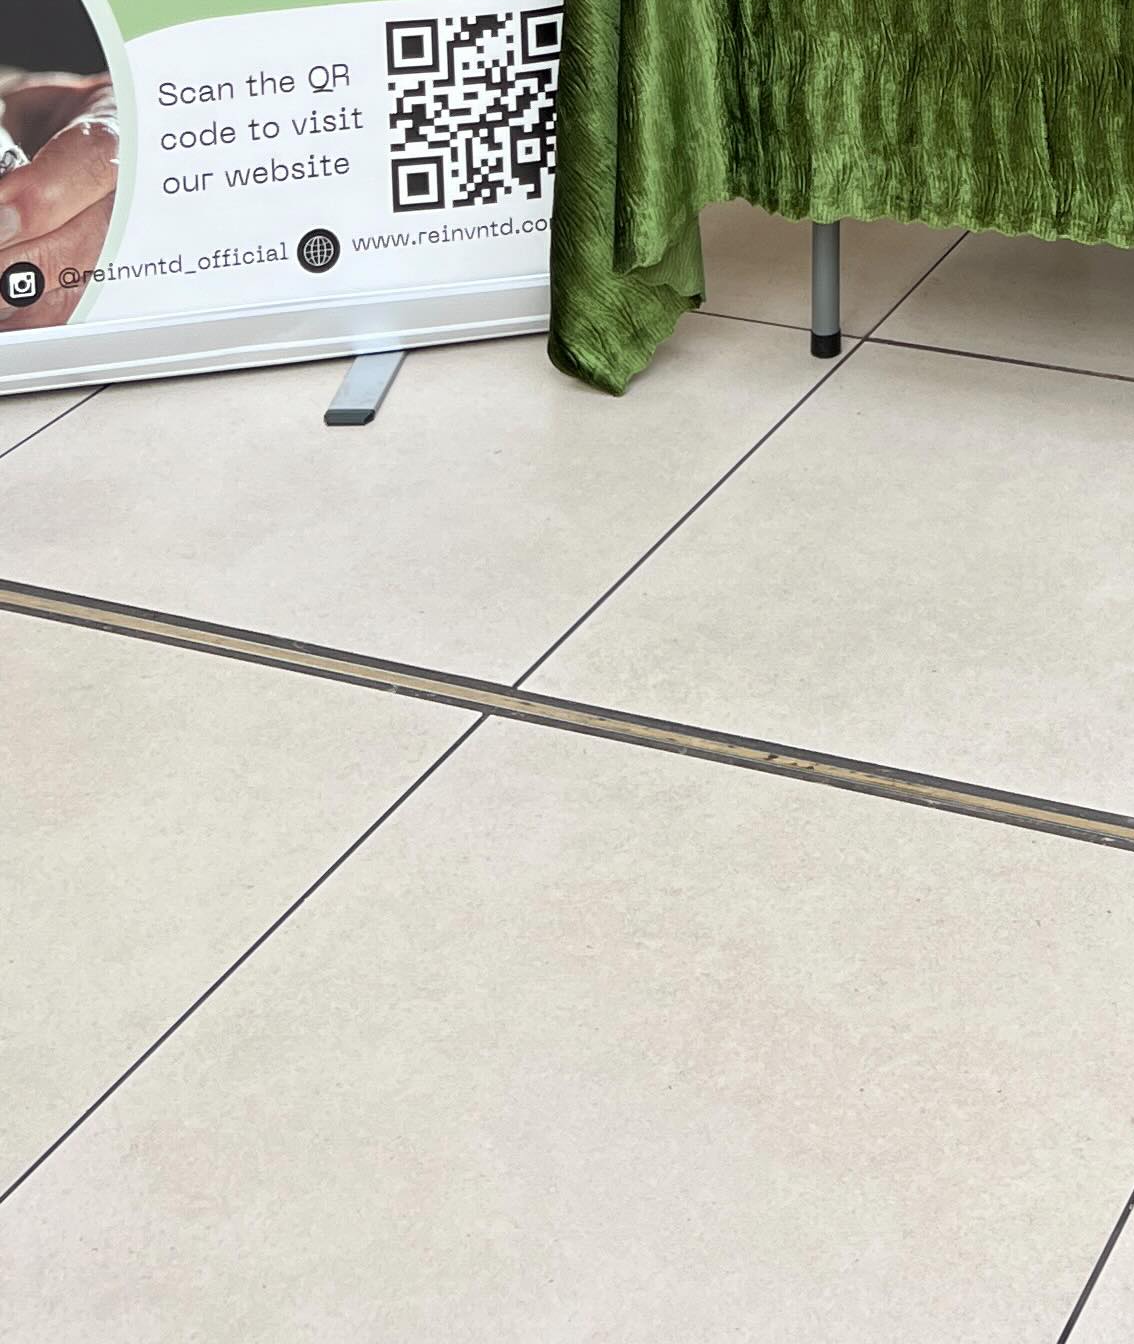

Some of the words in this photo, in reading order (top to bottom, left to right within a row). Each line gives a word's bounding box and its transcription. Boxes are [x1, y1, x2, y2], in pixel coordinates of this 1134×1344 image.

[158, 81, 235, 107] Scan
[245, 71, 296, 98] the
[308, 63, 351, 94] QR
[160, 120, 237, 151] code
[248, 118, 281, 141] to
[291, 106, 365, 136] visit
[163, 172, 214, 195] our
[225, 154, 350, 188] website
[58, 241, 290, 290] @reinvntd_official
